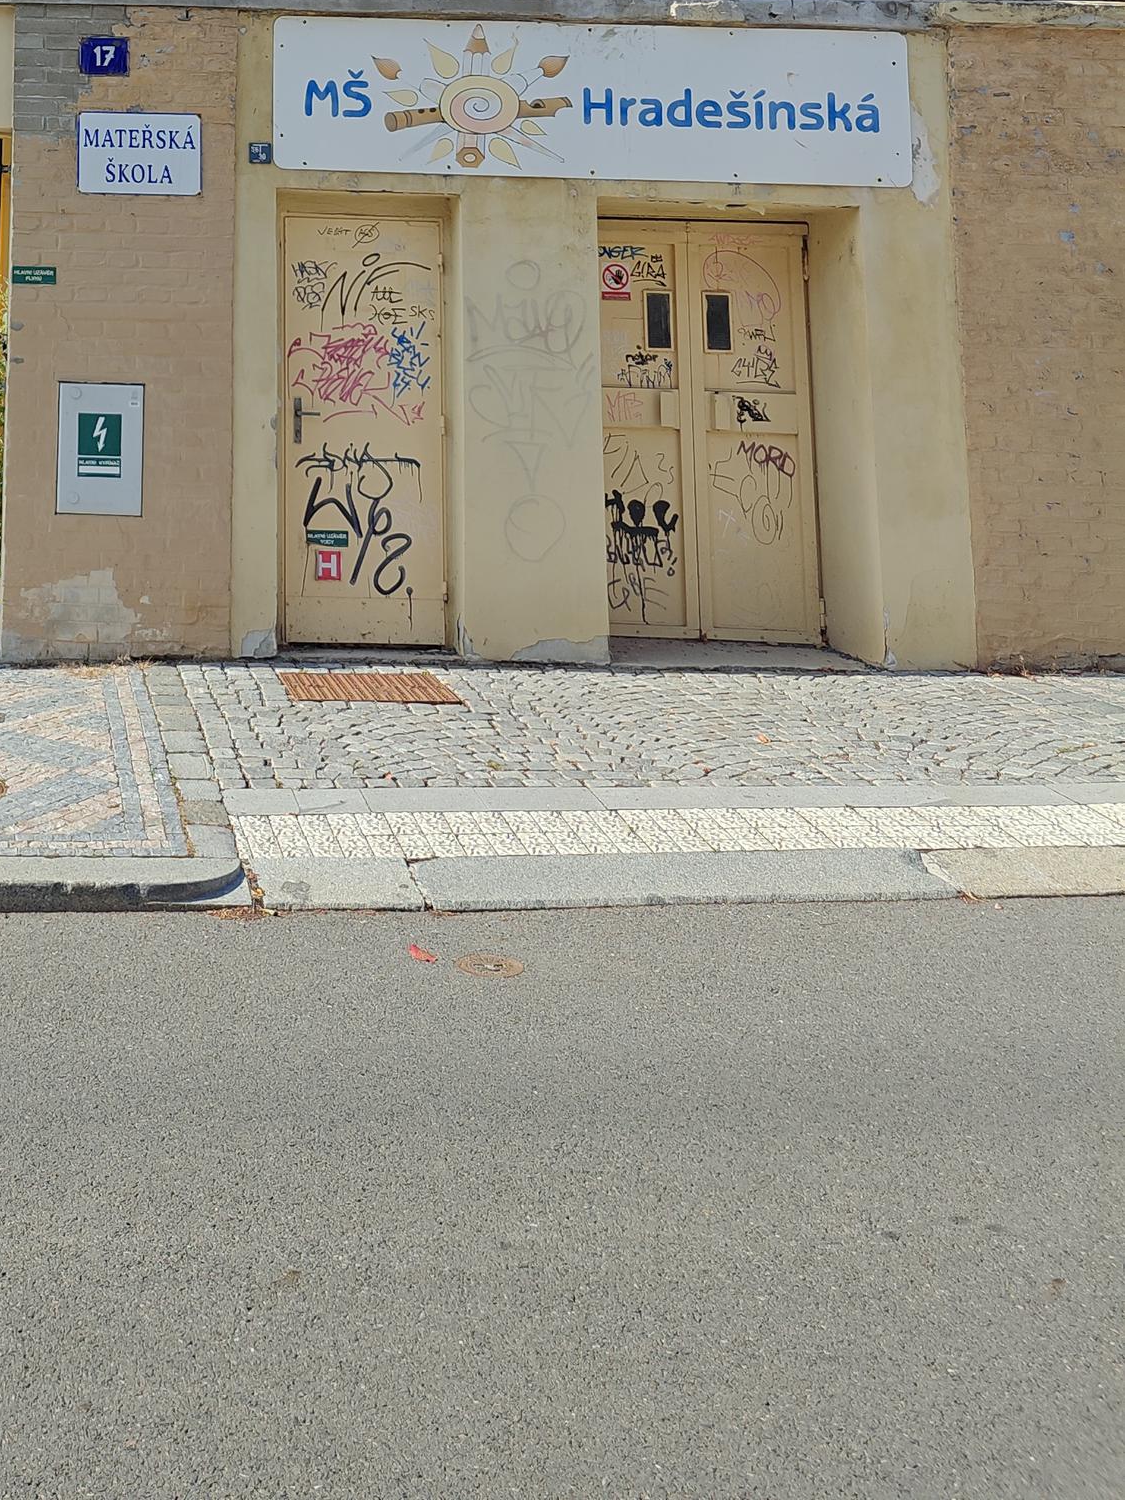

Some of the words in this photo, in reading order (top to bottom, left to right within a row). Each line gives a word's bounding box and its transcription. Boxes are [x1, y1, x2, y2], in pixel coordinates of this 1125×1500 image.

[92, 45, 117, 67] 17
[304, 68, 372, 118] MŠ
[583, 87, 880, 134] Hradešínská
[83, 124, 196, 150] MATEŘSKÁ
[105, 157, 173, 184] ŠKOLA
[317, 554, 337, 577] H
